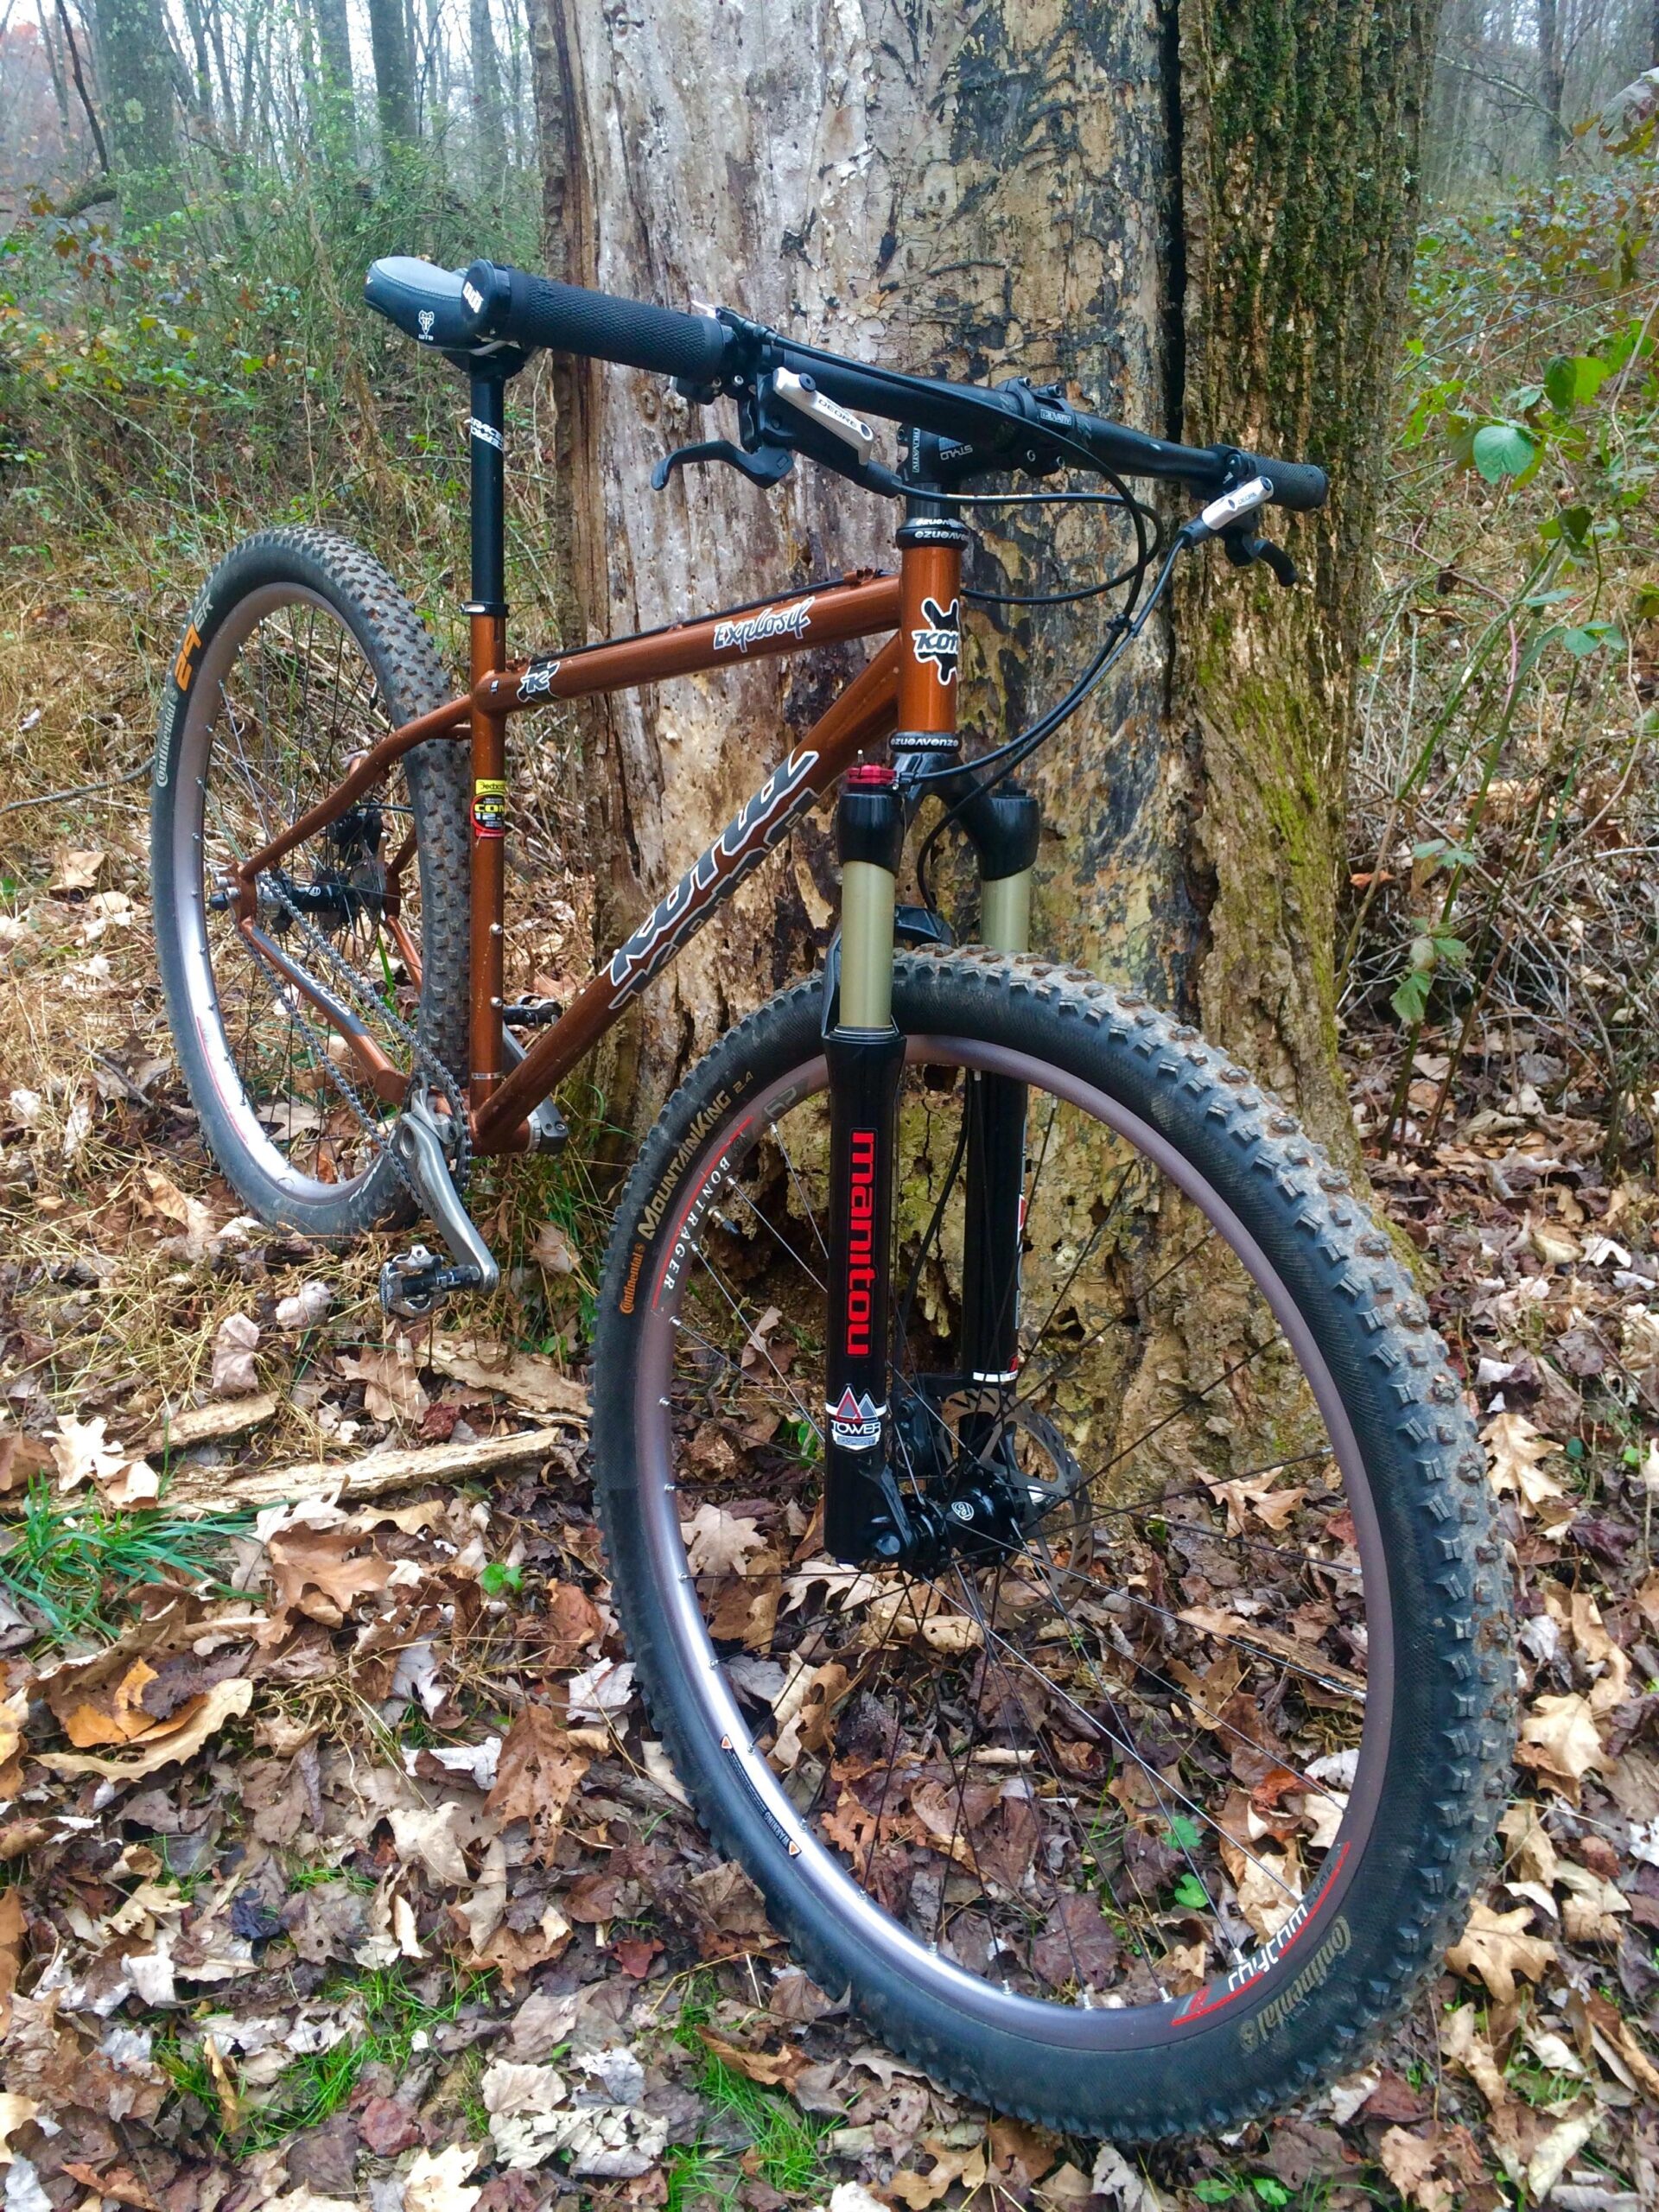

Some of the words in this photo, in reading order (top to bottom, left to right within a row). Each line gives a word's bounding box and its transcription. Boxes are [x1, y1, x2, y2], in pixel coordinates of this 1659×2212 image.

[817, 397, 857, 429] DEORE
[155, 700, 176, 788] Continental
[732, 1071, 753, 1095] 2.4
[663, 1155, 731, 1290] BONTRAGER
[846, 1131, 877, 1356] manitou
[620, 1250, 644, 1314] Continental
[830, 1420, 881, 1434] TOWER
[764, 1811, 790, 1847] WARNING
[1255, 1915, 1351, 2042] Continental
